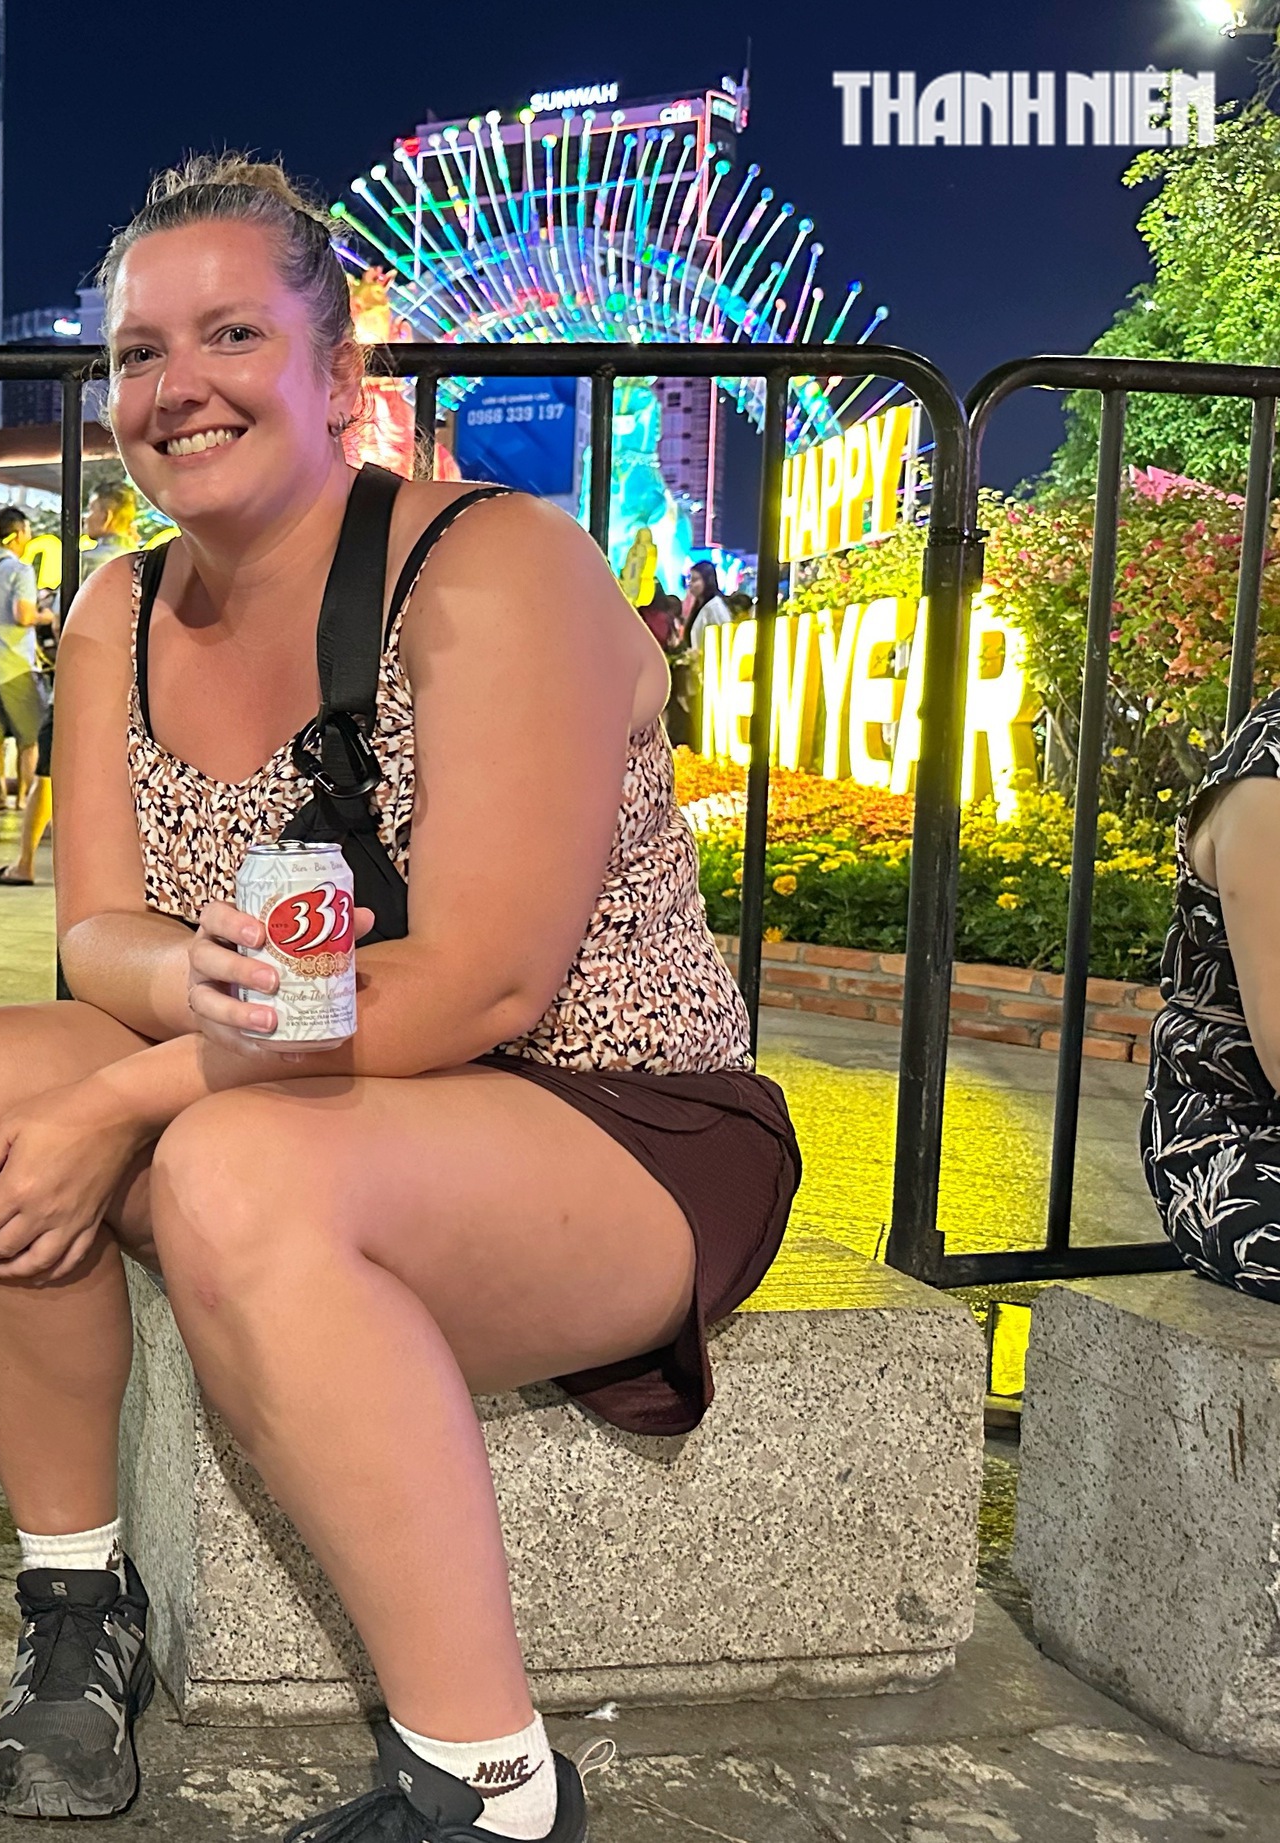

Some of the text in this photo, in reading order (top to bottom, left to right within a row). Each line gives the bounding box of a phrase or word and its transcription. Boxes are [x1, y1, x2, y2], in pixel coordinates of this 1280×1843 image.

[530, 82, 618, 113] SUNWAH
[538, 403, 565, 421] 197
[779, 407, 902, 563] HAPPY
[702, 612, 815, 774] NEW
[279, 881, 351, 953] 333
[281, 990, 307, 1003] Triple
[473, 1754, 529, 1784] NIKE
